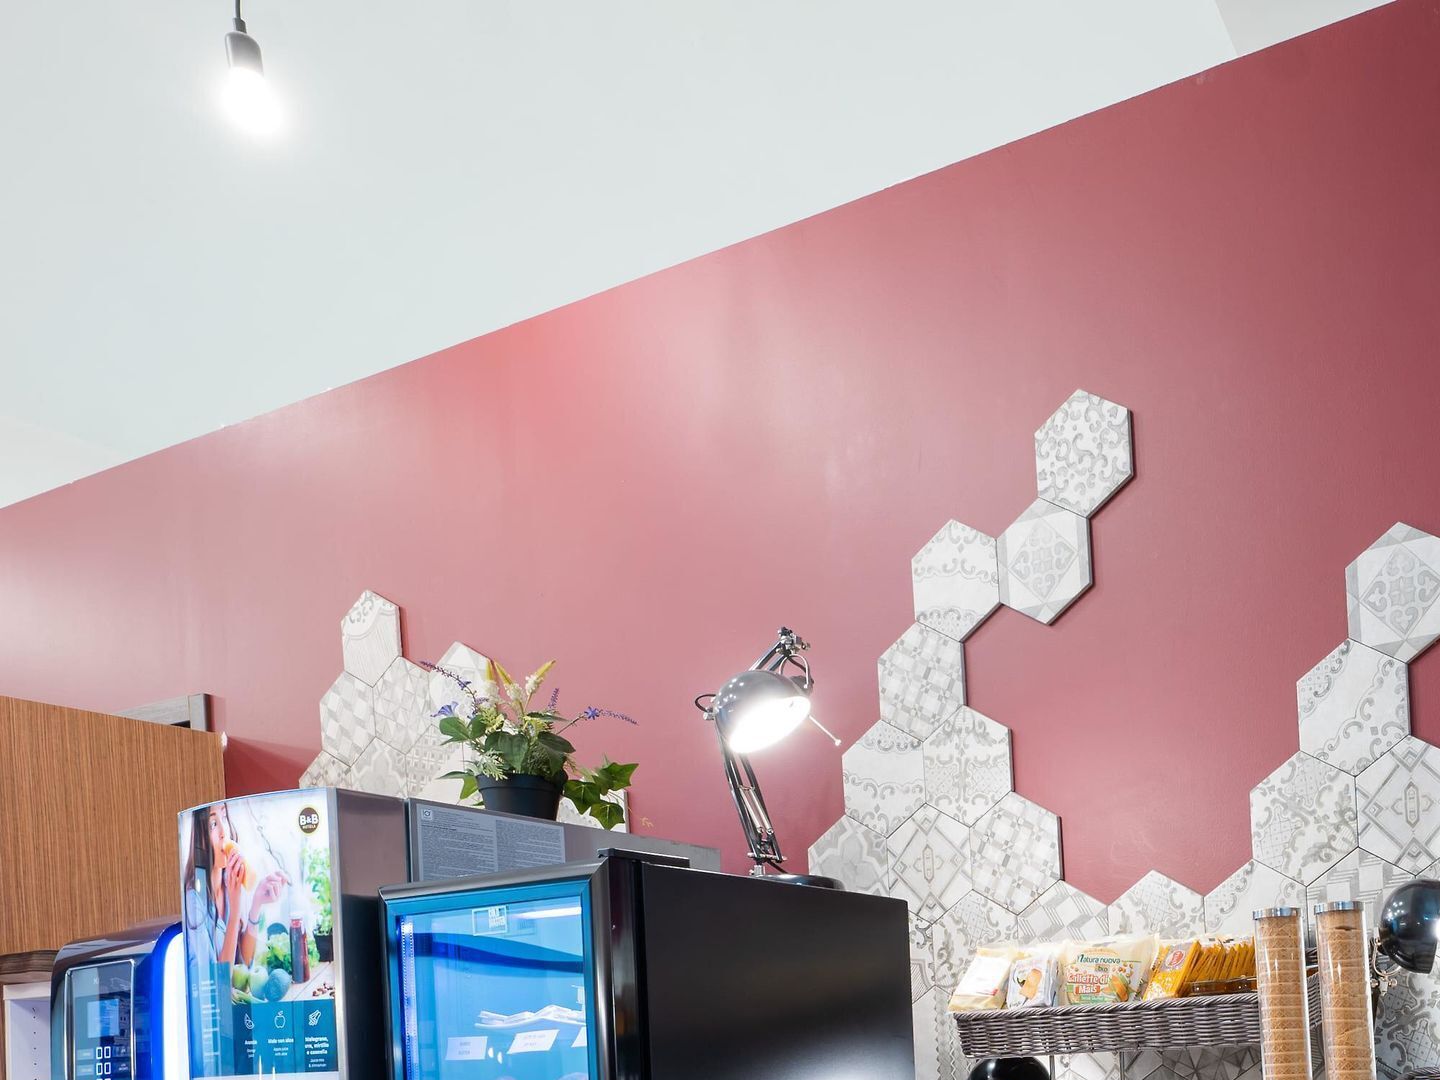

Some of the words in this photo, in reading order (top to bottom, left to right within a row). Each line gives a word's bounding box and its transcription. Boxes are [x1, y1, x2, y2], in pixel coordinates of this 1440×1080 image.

[300, 814, 318, 825] B&B
[1100, 956, 1121, 964] nuova
[1078, 984, 1097, 994] Mais
